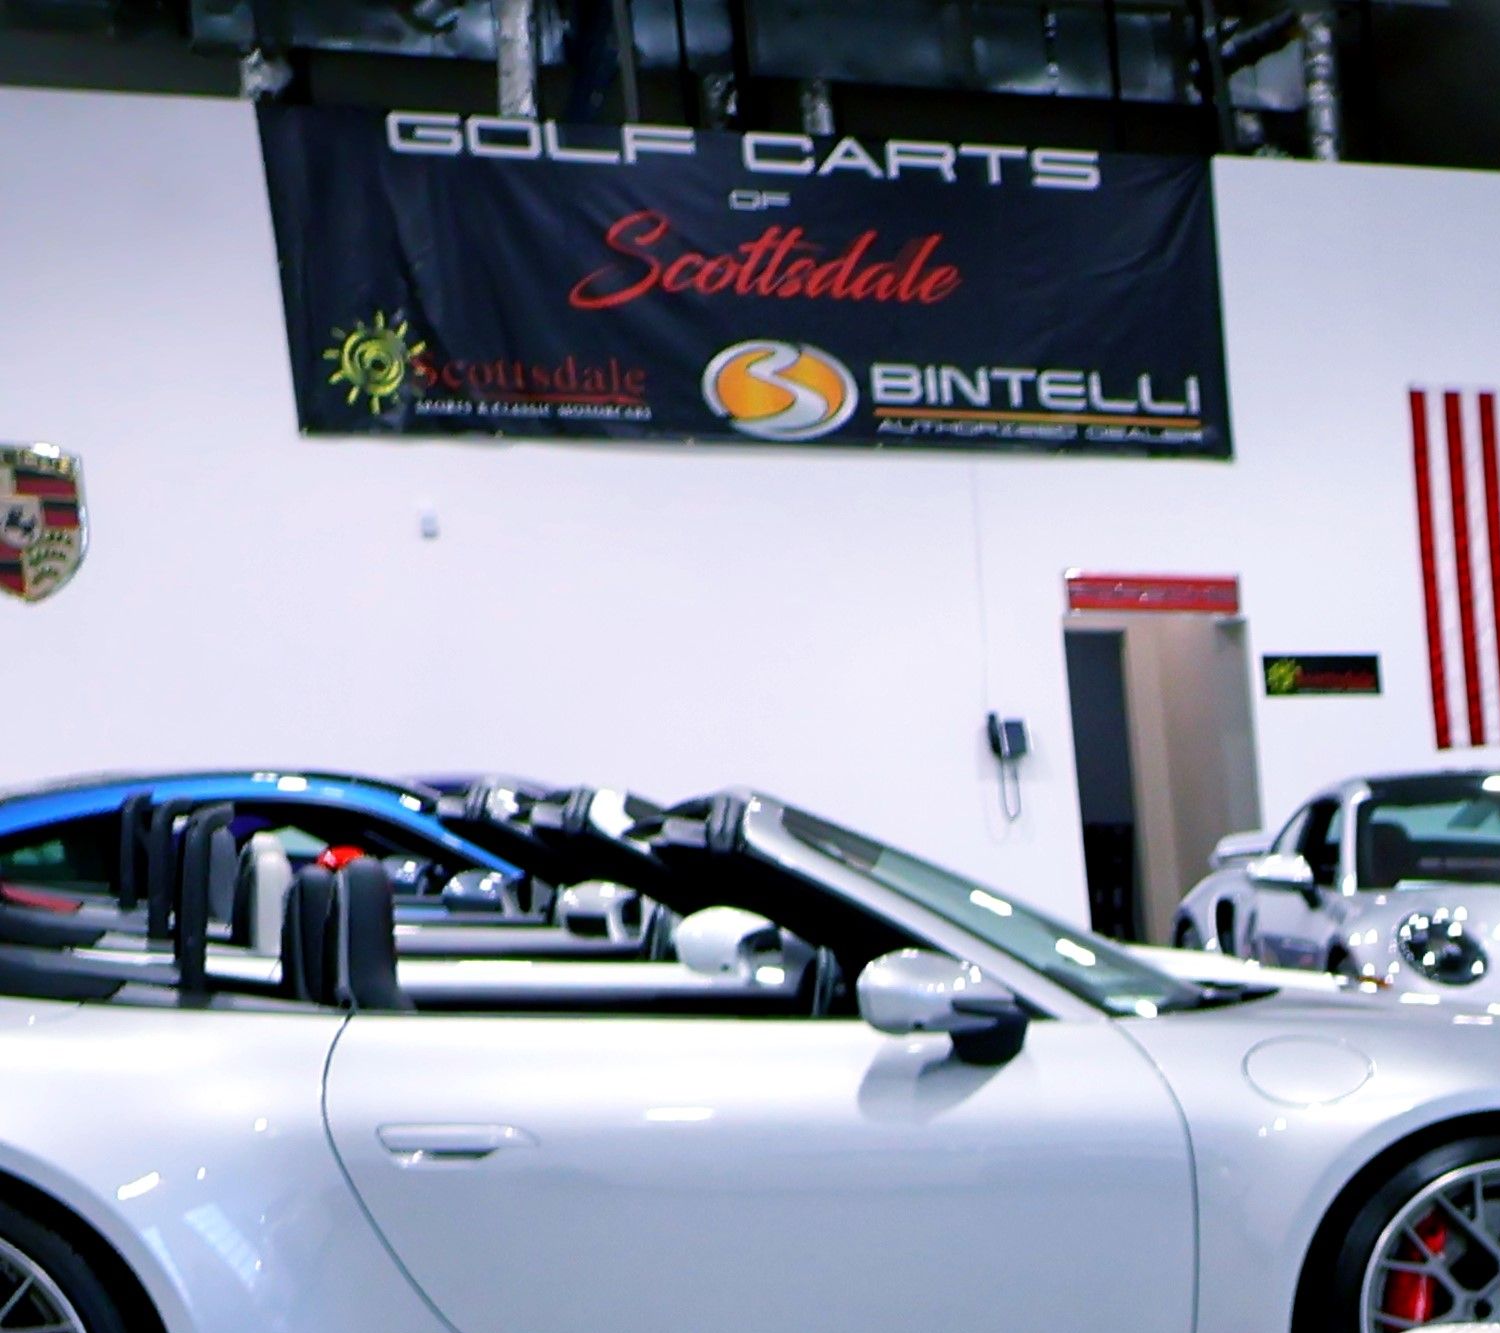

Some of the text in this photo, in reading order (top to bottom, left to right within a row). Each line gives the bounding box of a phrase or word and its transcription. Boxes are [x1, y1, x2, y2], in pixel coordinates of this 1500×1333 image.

[386, 112, 1102, 191] GOLF CARTS
[728, 189, 791, 211] OF
[568, 209, 963, 311] Scottsdale
[411, 351, 646, 394] Scottsdale
[869, 361, 1201, 416] BINTELLI
